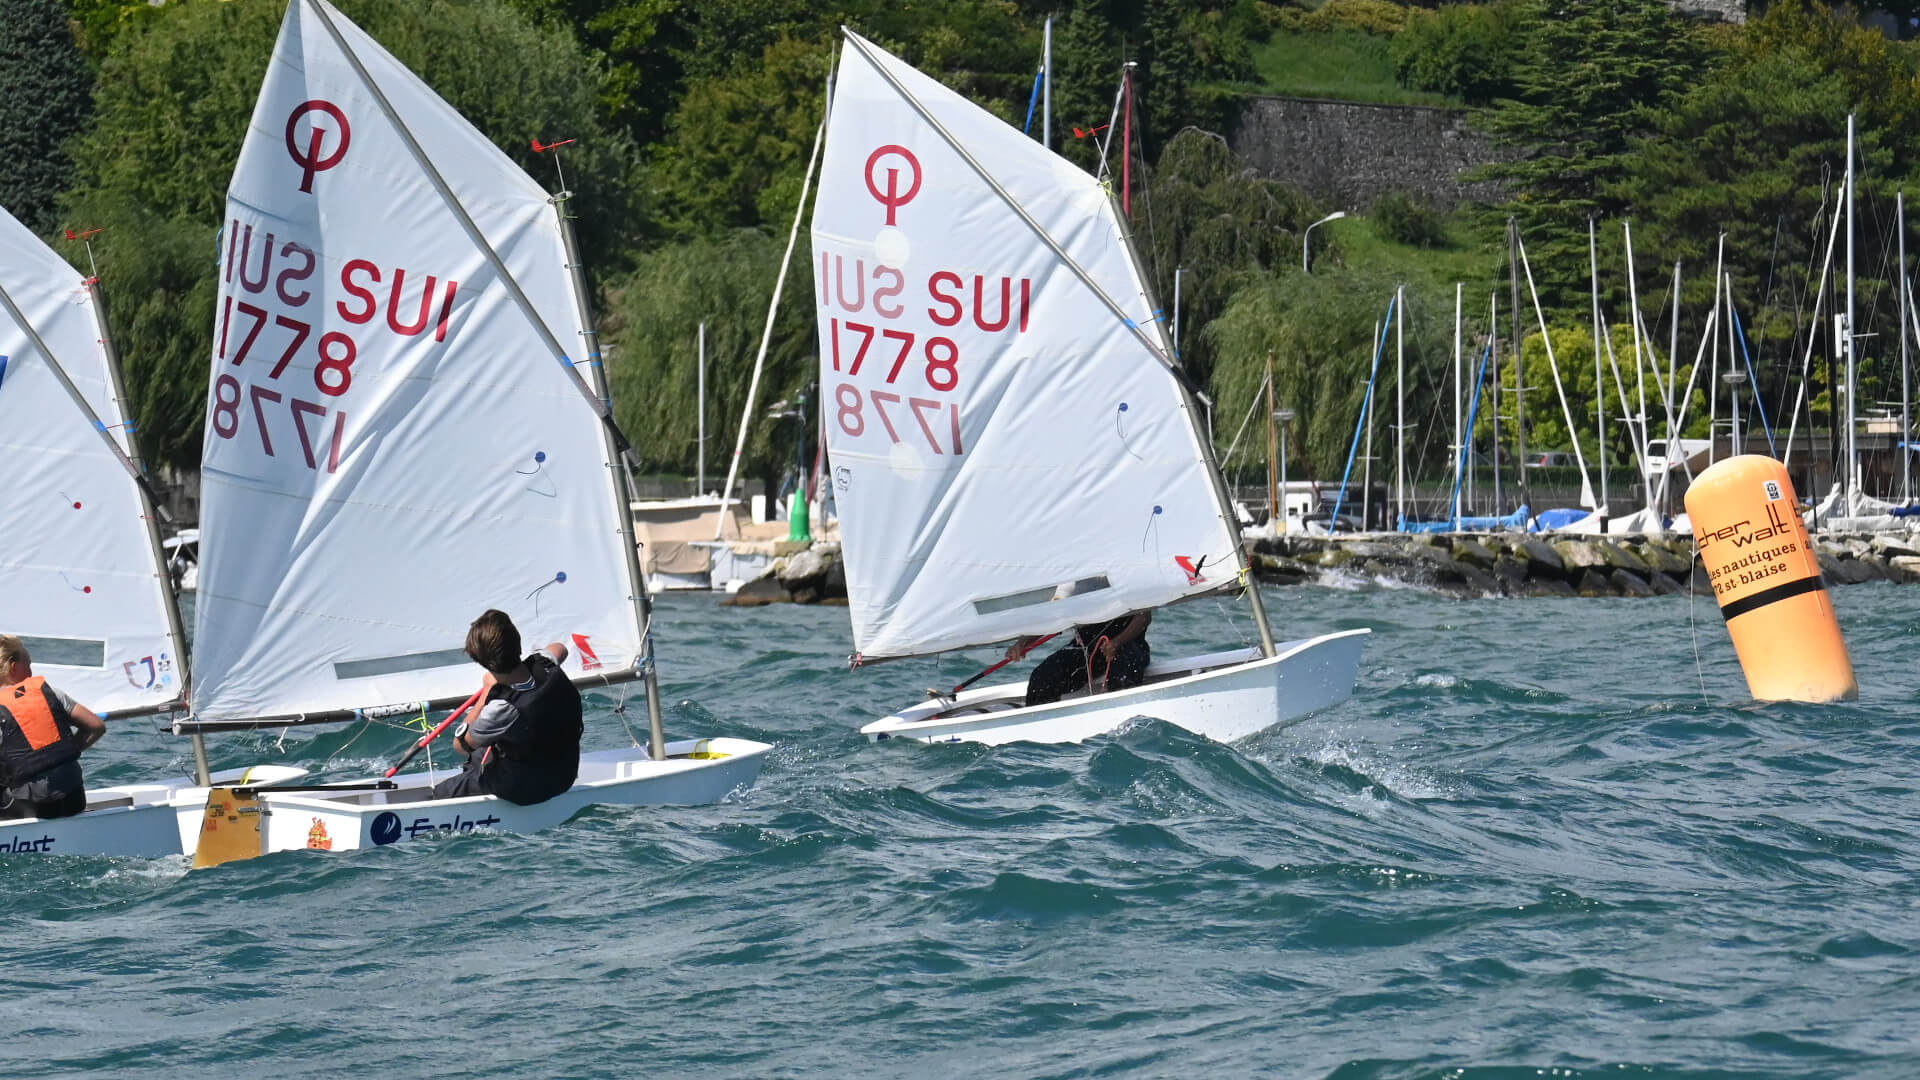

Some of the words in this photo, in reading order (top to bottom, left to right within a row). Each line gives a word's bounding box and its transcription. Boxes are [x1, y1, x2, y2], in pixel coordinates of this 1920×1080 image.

[336, 259, 458, 343] SUI
[928, 271, 1031, 333] SUI
[219, 295, 357, 397] 1778
[831, 317, 959, 392] 1778
[1722, 543, 1797, 574] nautiques
